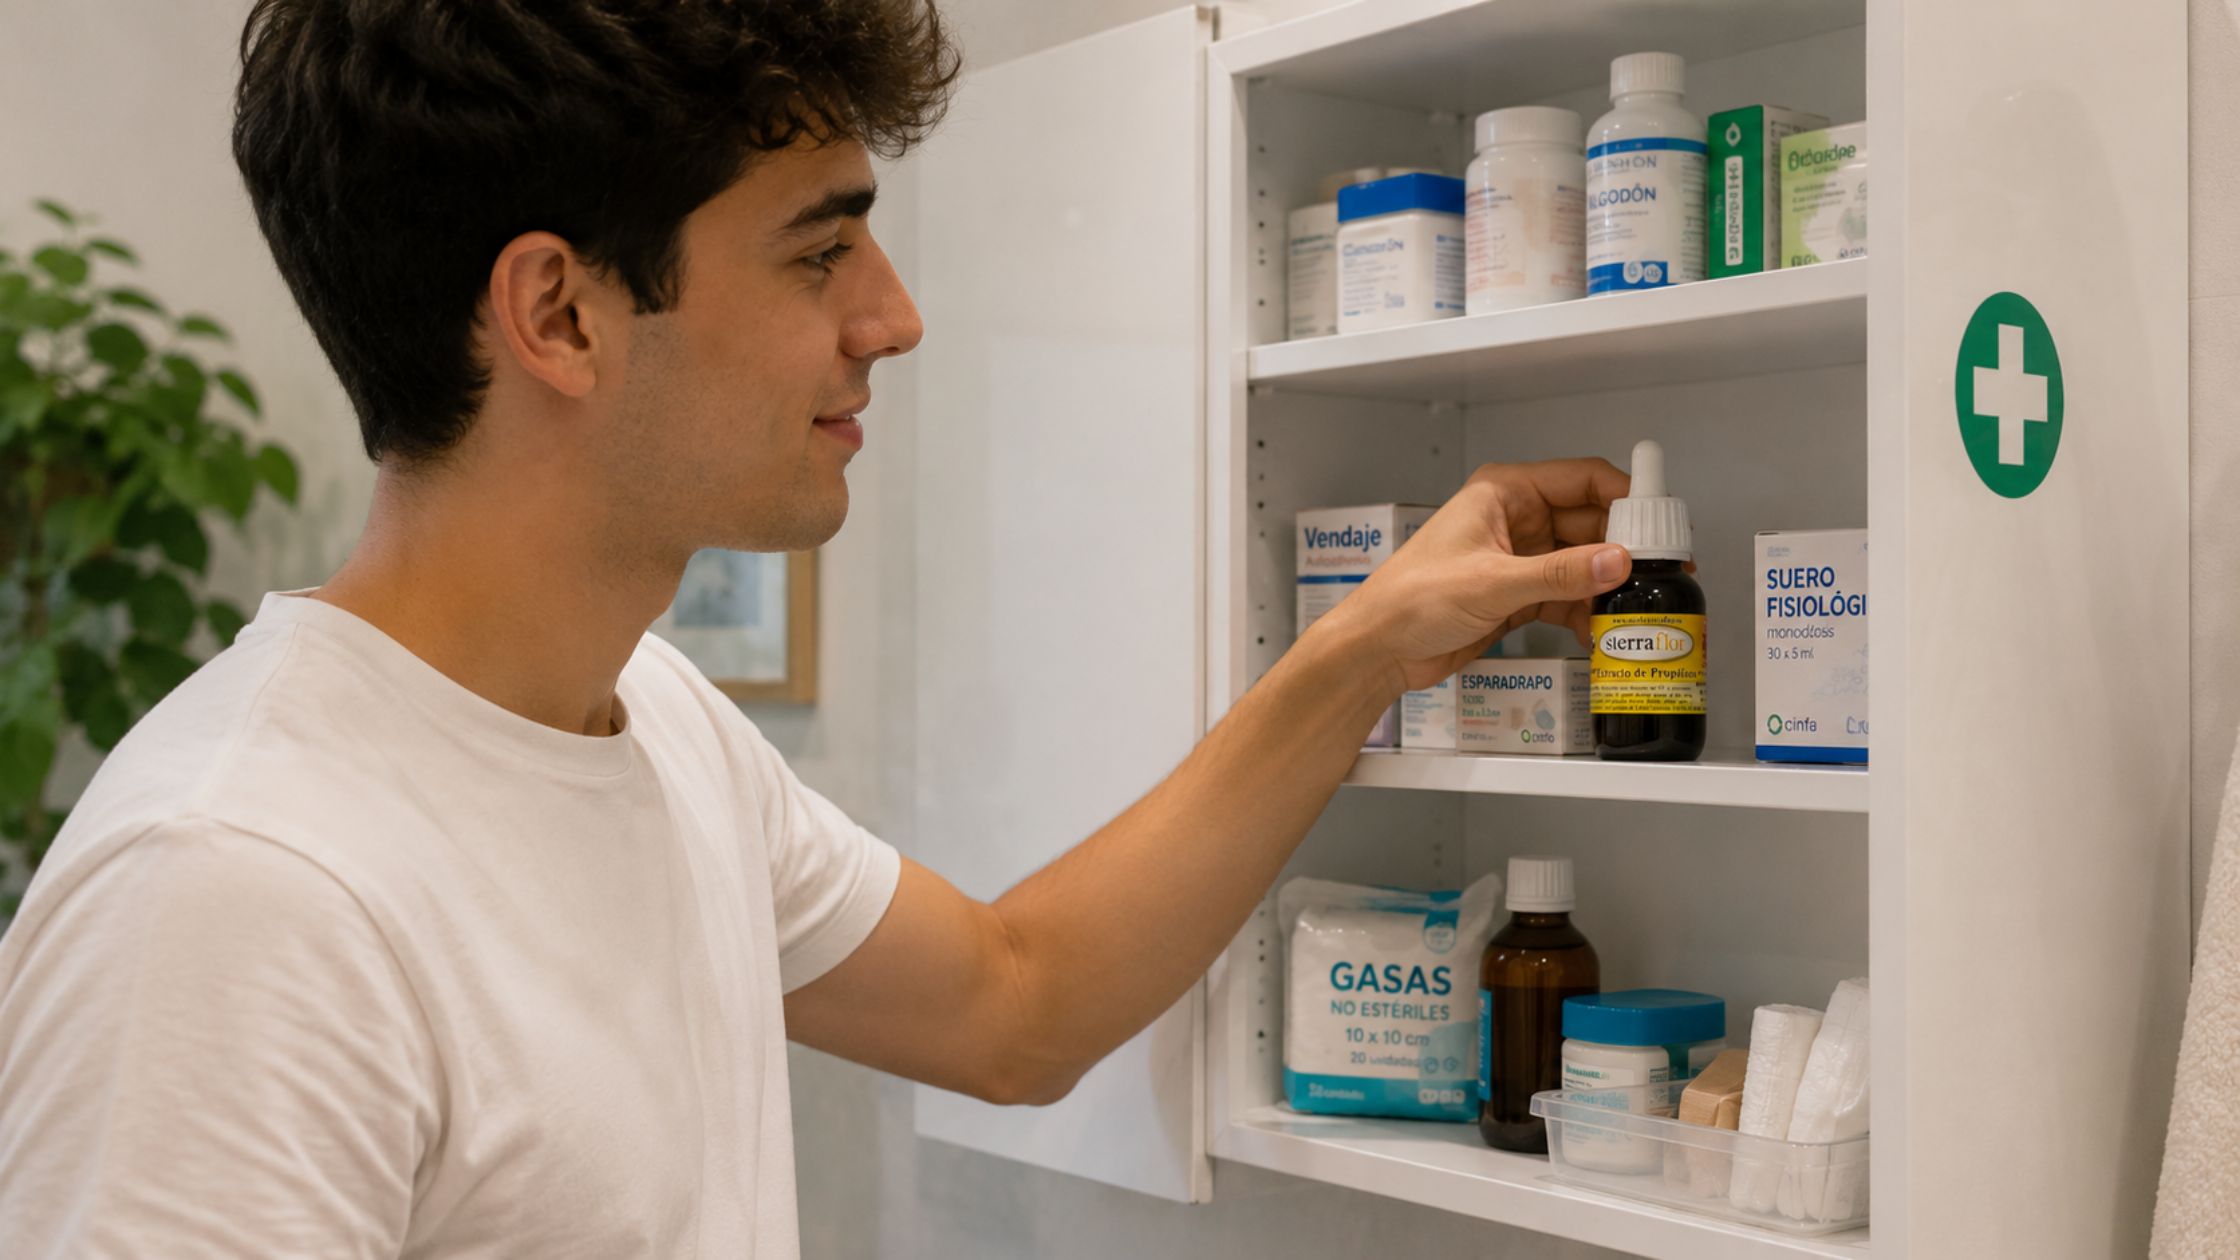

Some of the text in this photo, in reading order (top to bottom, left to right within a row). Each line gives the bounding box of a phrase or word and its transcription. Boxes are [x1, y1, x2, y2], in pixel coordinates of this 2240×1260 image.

[1304, 523, 1382, 552] Vendaje
[1767, 566, 1835, 590] SUERO
[1767, 590, 1867, 617] FISIOLÓGI
[1767, 647, 1781, 660] 30
[1791, 647, 1799, 660] 5
[1462, 675, 1553, 690] ESPARADRAPO
[1785, 717, 1817, 732] cinfa
[1330, 961, 1452, 996] GASAS
[1331, 997, 1450, 1021] NO ESTÉRILES
[1345, 1028, 1430, 1047] 10 x 10 cm
[1351, 1051, 1366, 1064] 20
